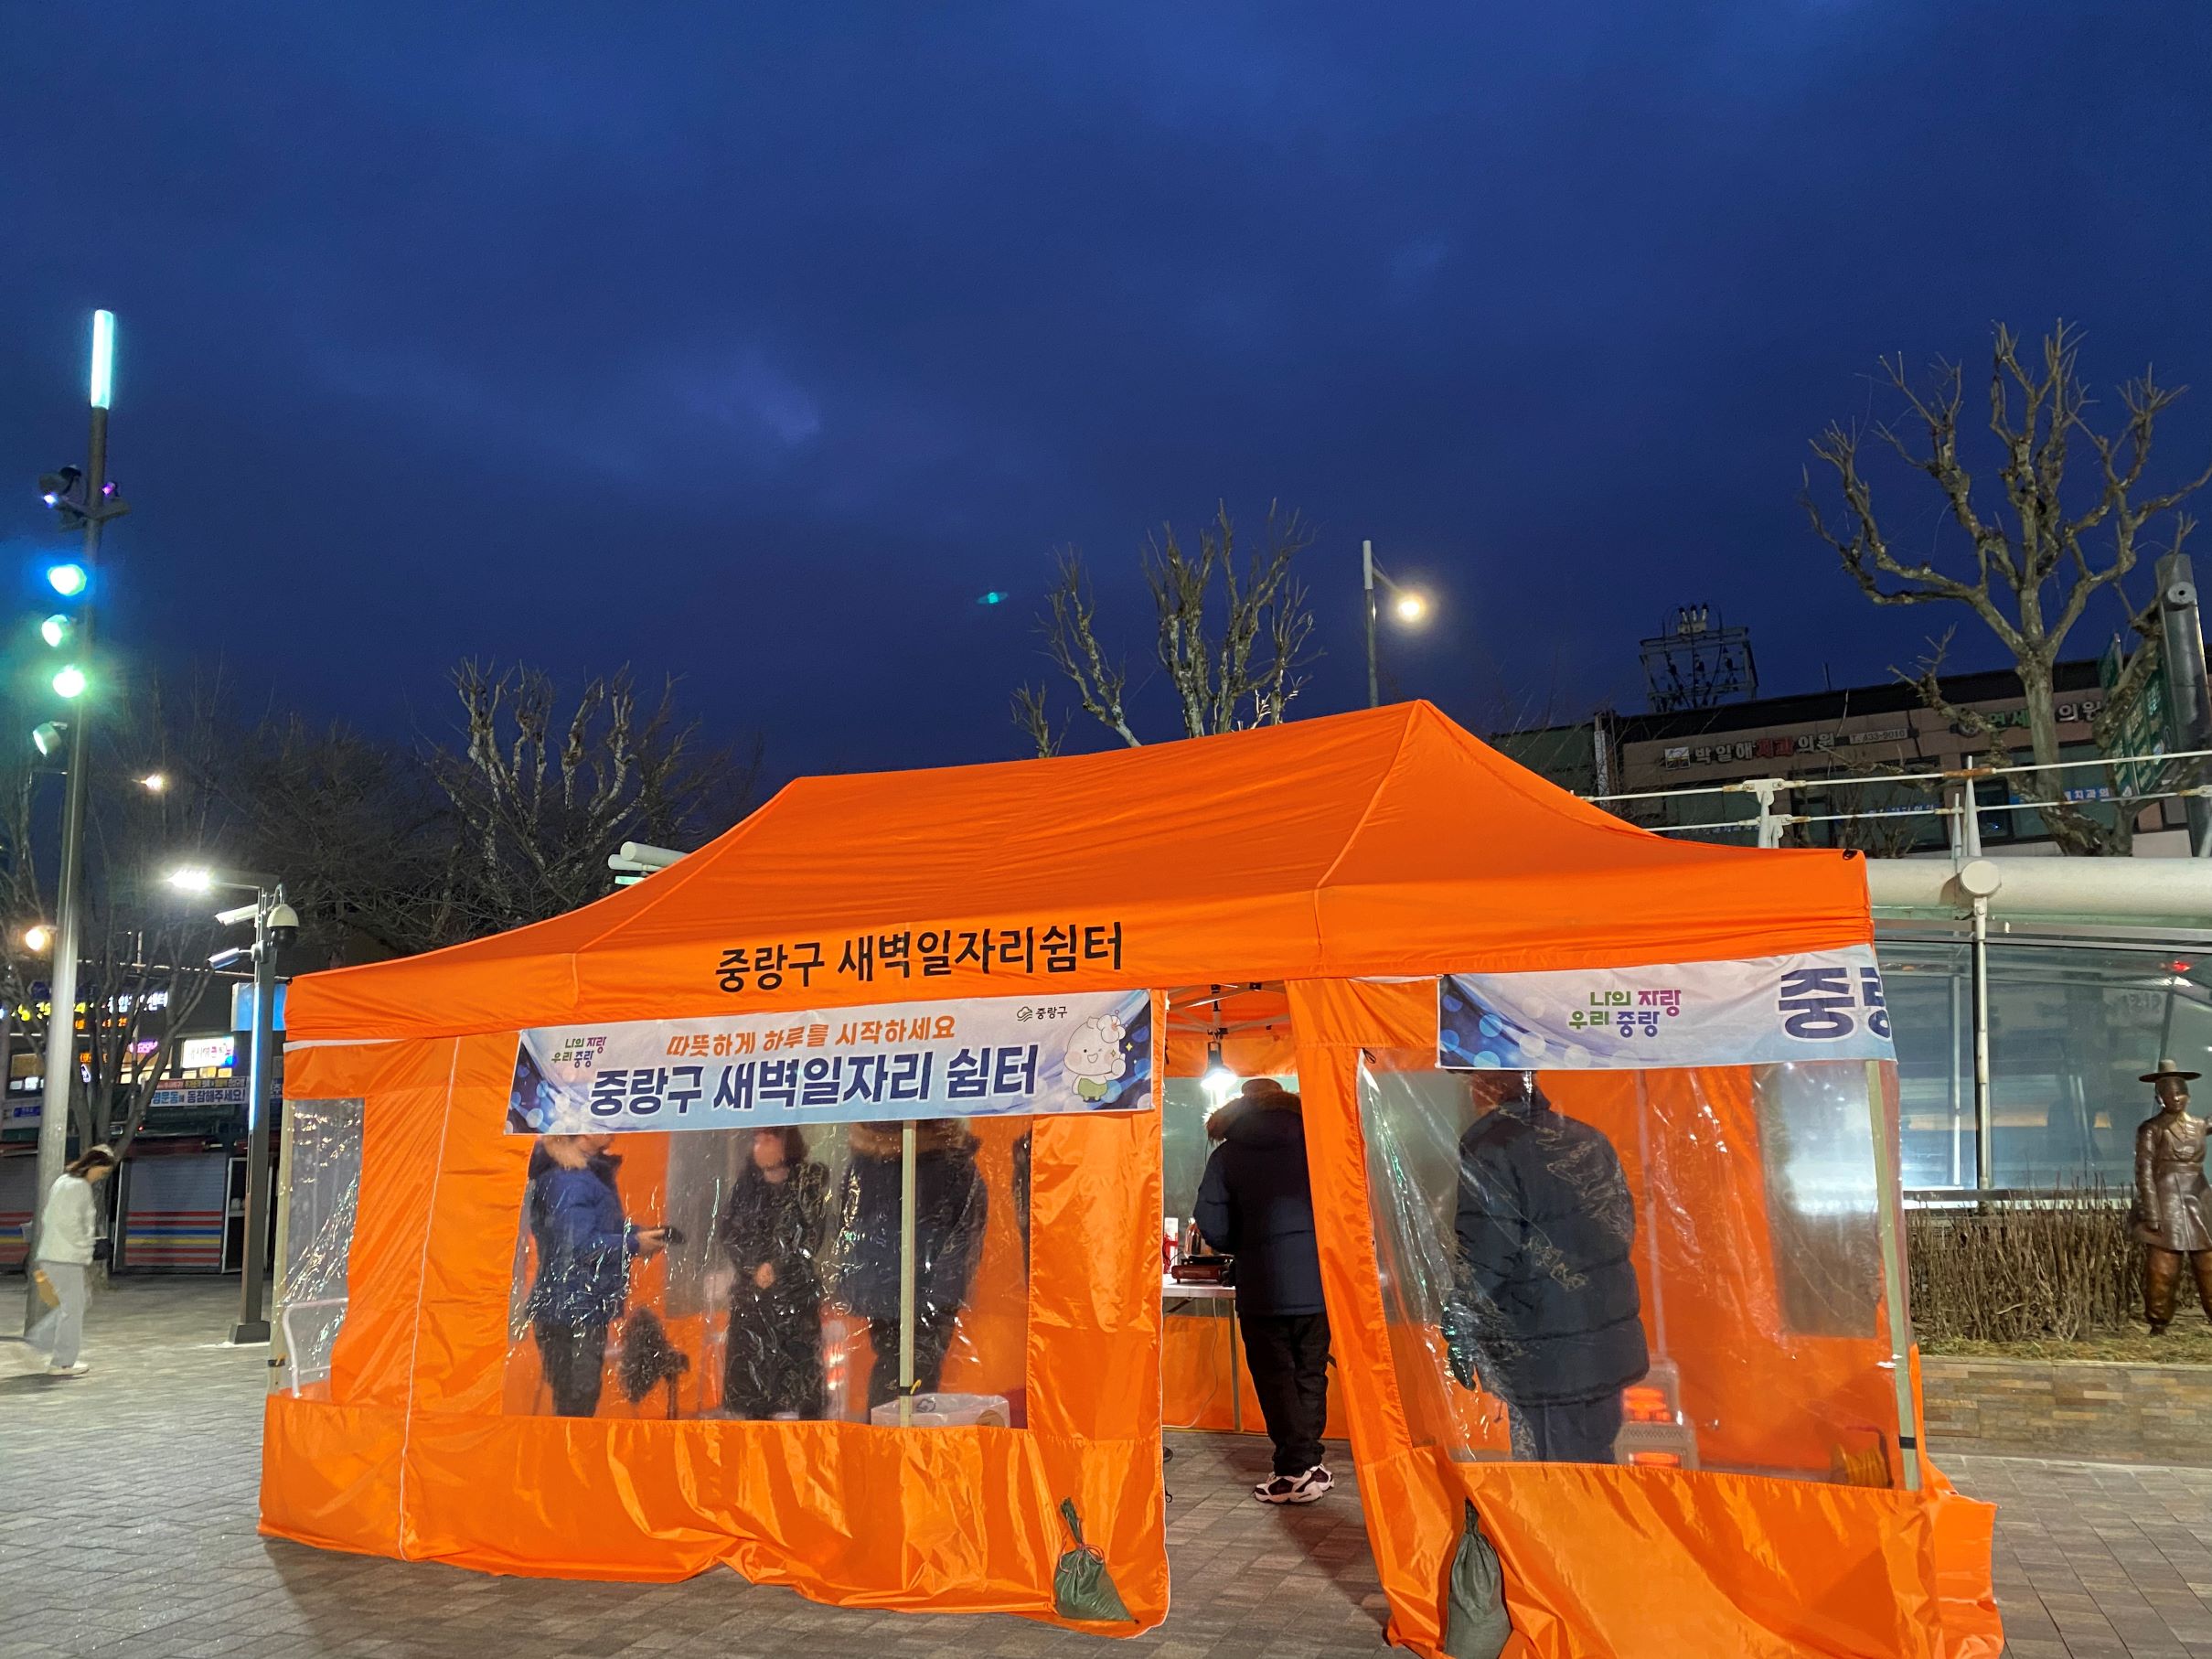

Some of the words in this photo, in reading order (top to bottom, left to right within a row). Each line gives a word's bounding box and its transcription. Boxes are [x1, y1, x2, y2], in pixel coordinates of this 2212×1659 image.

[715, 941, 825, 992] 중랑구
[837, 921, 1122, 982] 새벽일자리쉼터
[1035, 1006, 1068, 1020] 중랑구
[1590, 990, 1631, 1006] 나의
[1638, 990, 1682, 1017] 자랑
[667, 1032, 757, 1058] 따뜻하게
[763, 1023, 828, 1051] 하루를
[835, 1015, 956, 1046] 시작하세요
[1569, 1011, 1609, 1030] 우리
[1617, 1011, 1661, 1038] 중랑
[565, 1037, 584, 1048] 나의
[586, 1036, 607, 1054] 자랑
[551, 1052, 572, 1063] 우리
[573, 1051, 594, 1068] 중랑
[590, 1065, 704, 1117] 중랑구
[713, 1052, 934, 1109] 새벽일자리
[946, 1044, 1039, 1098] 쉼터
